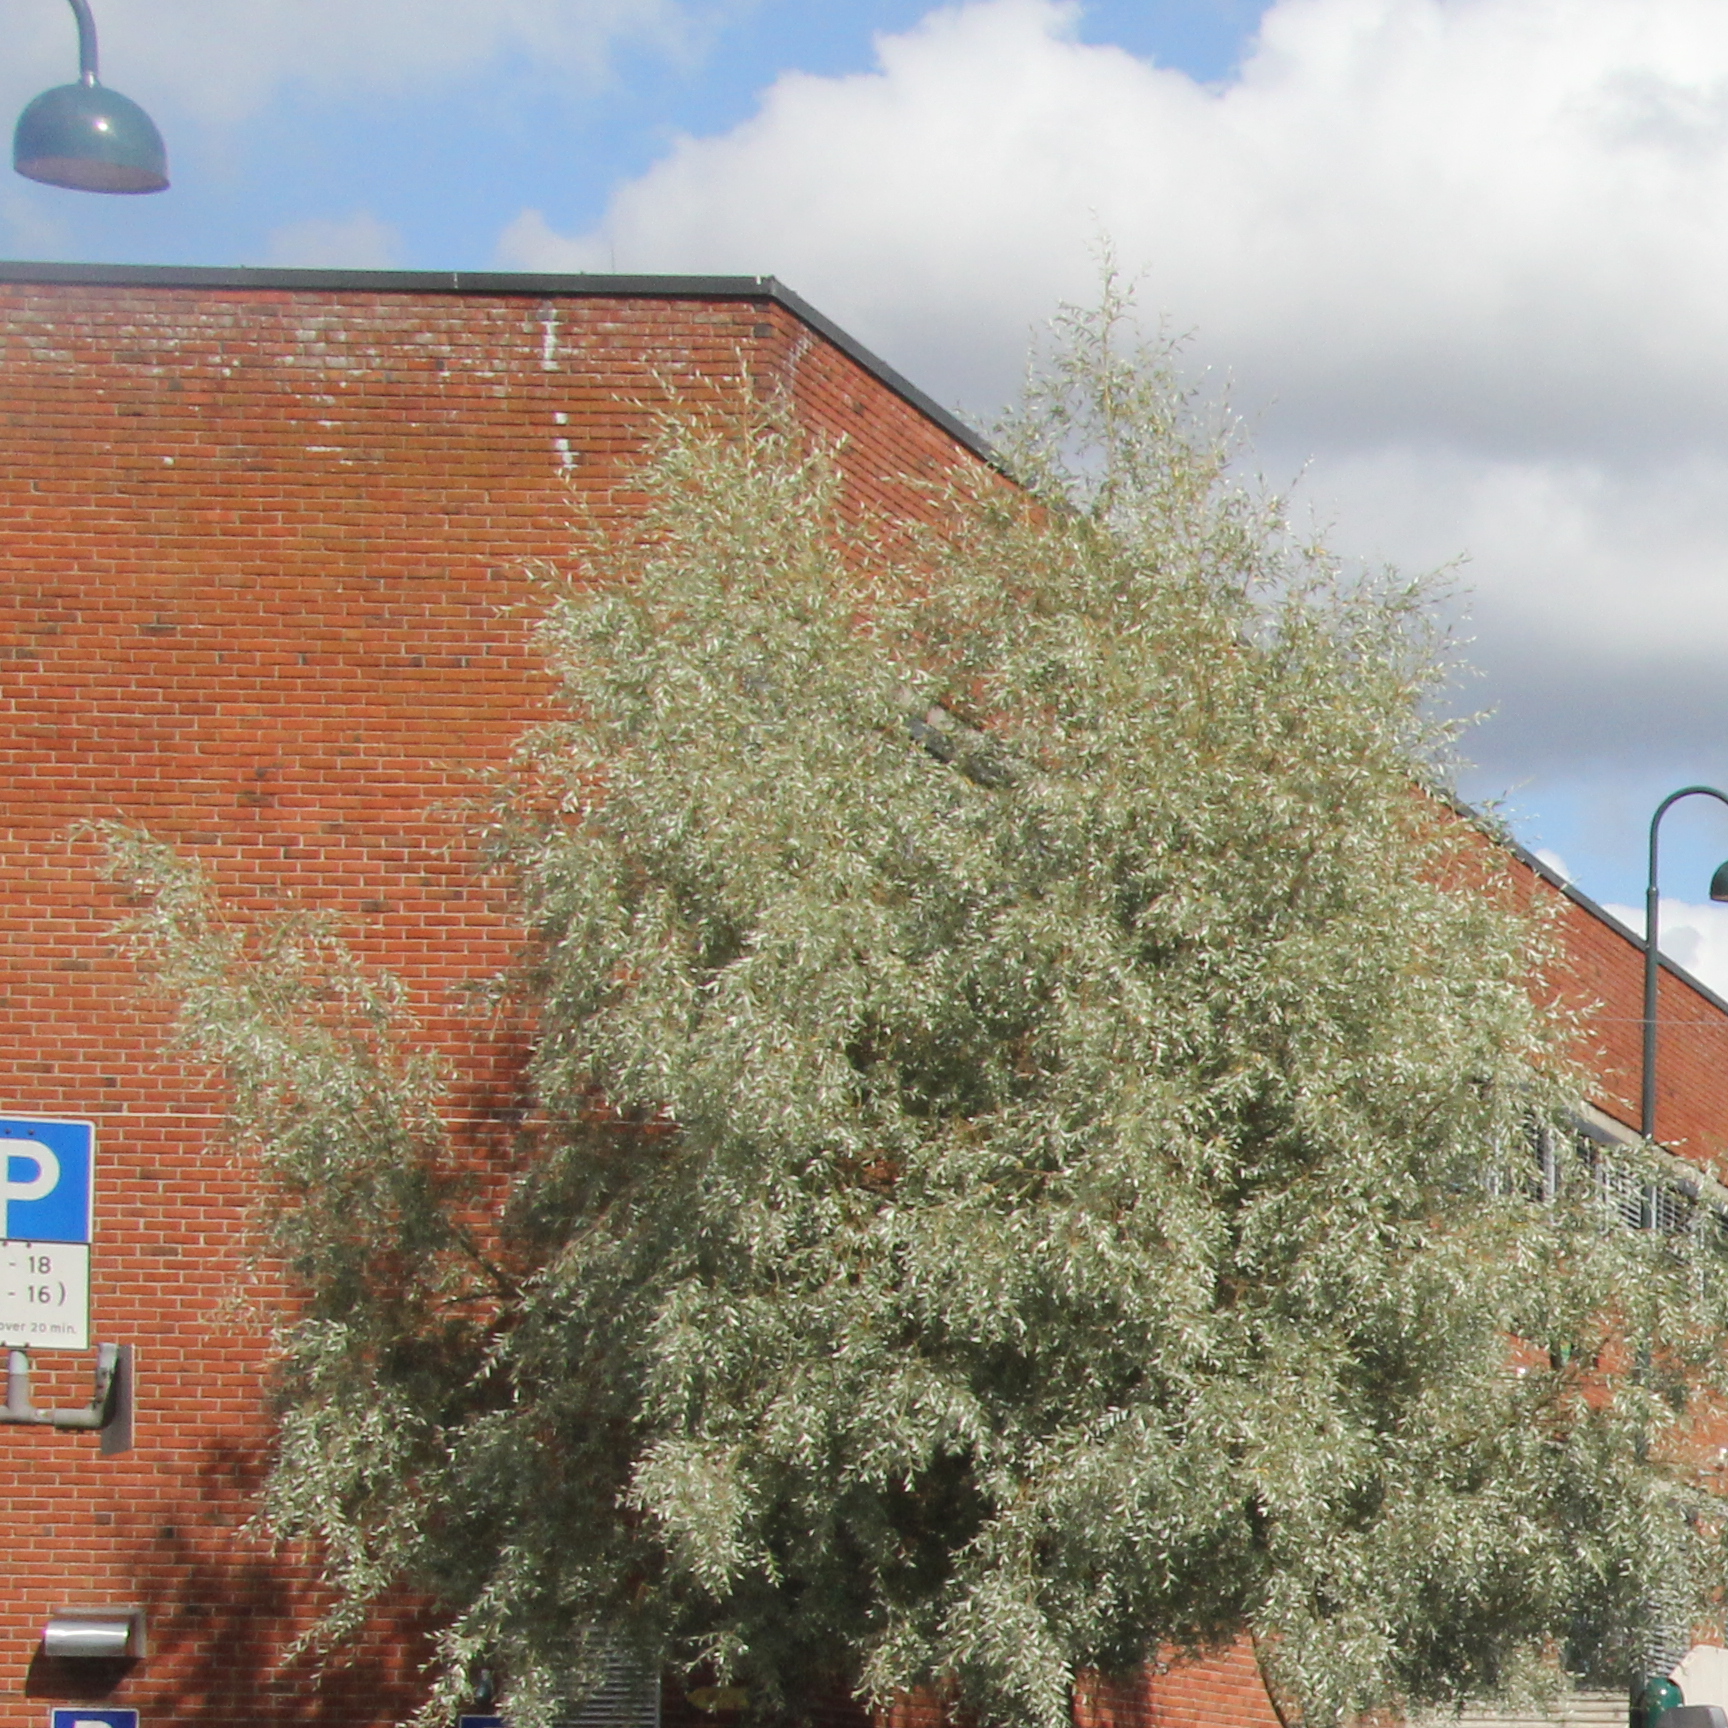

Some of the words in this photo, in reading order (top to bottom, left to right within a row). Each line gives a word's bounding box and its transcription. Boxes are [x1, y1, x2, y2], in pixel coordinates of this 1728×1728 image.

[0, 1138, 61, 1239] P
[28, 1256, 51, 1274] 18
[0, 1322, 26, 1333] over
[31, 1322, 46, 1333] 20
[50, 1322, 77, 1335] min.
